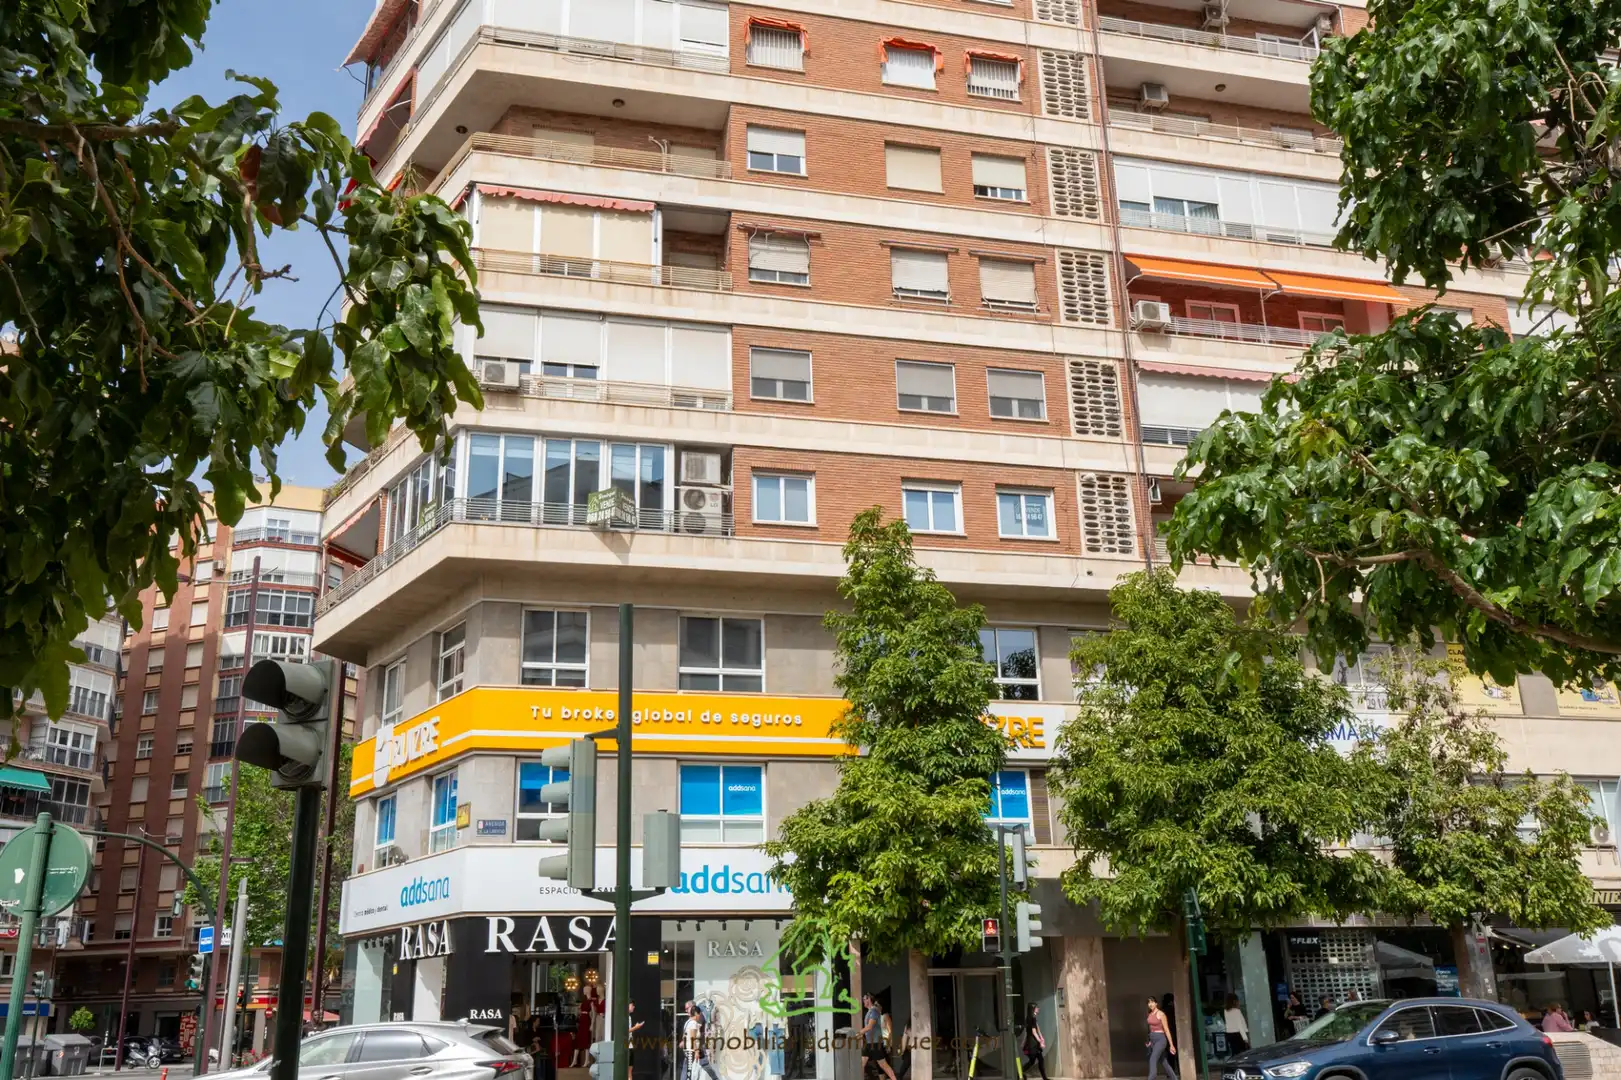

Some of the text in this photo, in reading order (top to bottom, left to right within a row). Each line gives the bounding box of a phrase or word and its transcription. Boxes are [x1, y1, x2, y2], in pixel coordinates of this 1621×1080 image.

[531, 705, 803, 727] Tu broke global de seguros
[1001, 787, 1026, 795] addsana
[671, 865, 793, 894] addsan
[400, 876, 449, 907] addsana
[539, 886, 579, 895] ESPACIO
[399, 919, 452, 960] RASA
[707, 940, 764, 957] RASA
[469, 1008, 502, 1020] RASA
